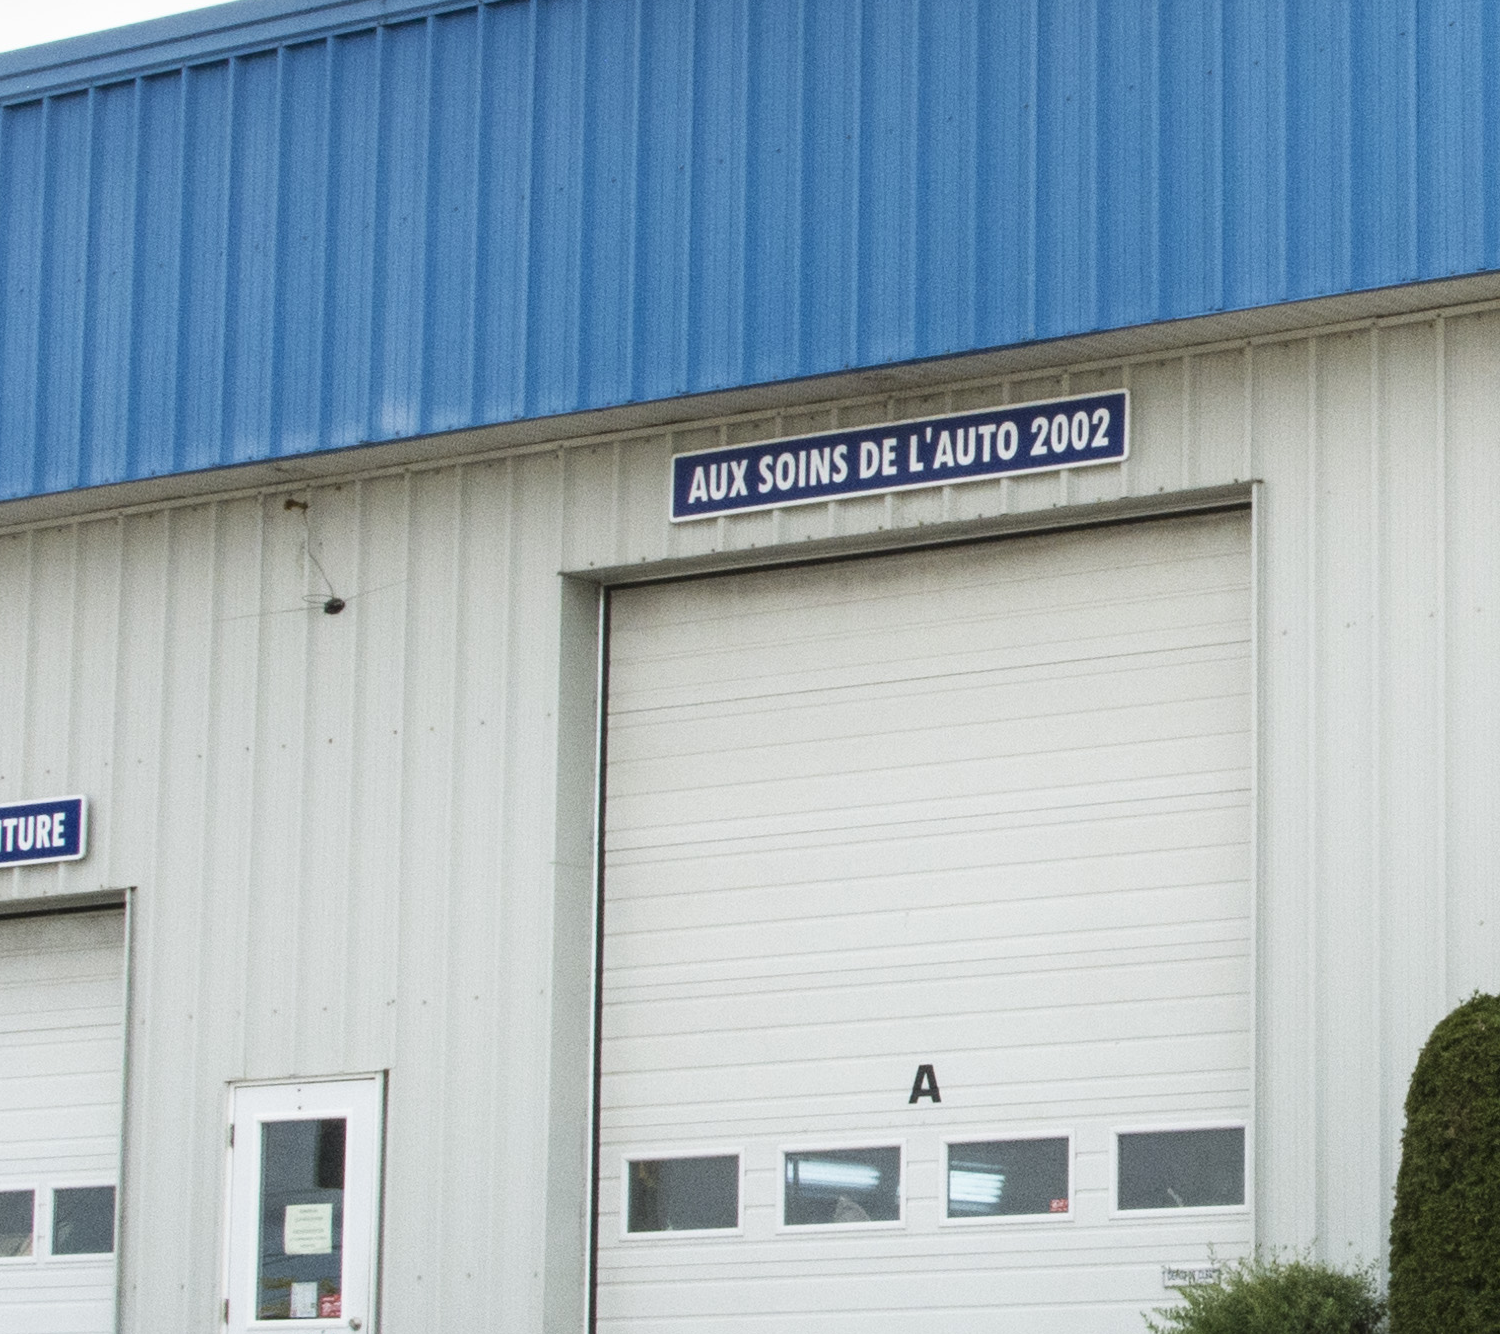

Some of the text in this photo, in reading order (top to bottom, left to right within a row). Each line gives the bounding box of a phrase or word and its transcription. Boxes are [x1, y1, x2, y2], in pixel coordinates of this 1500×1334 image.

[687, 407, 1111, 505] AUX SOINS DE L'AUTO 2002
[908, 1063, 943, 1105] A
